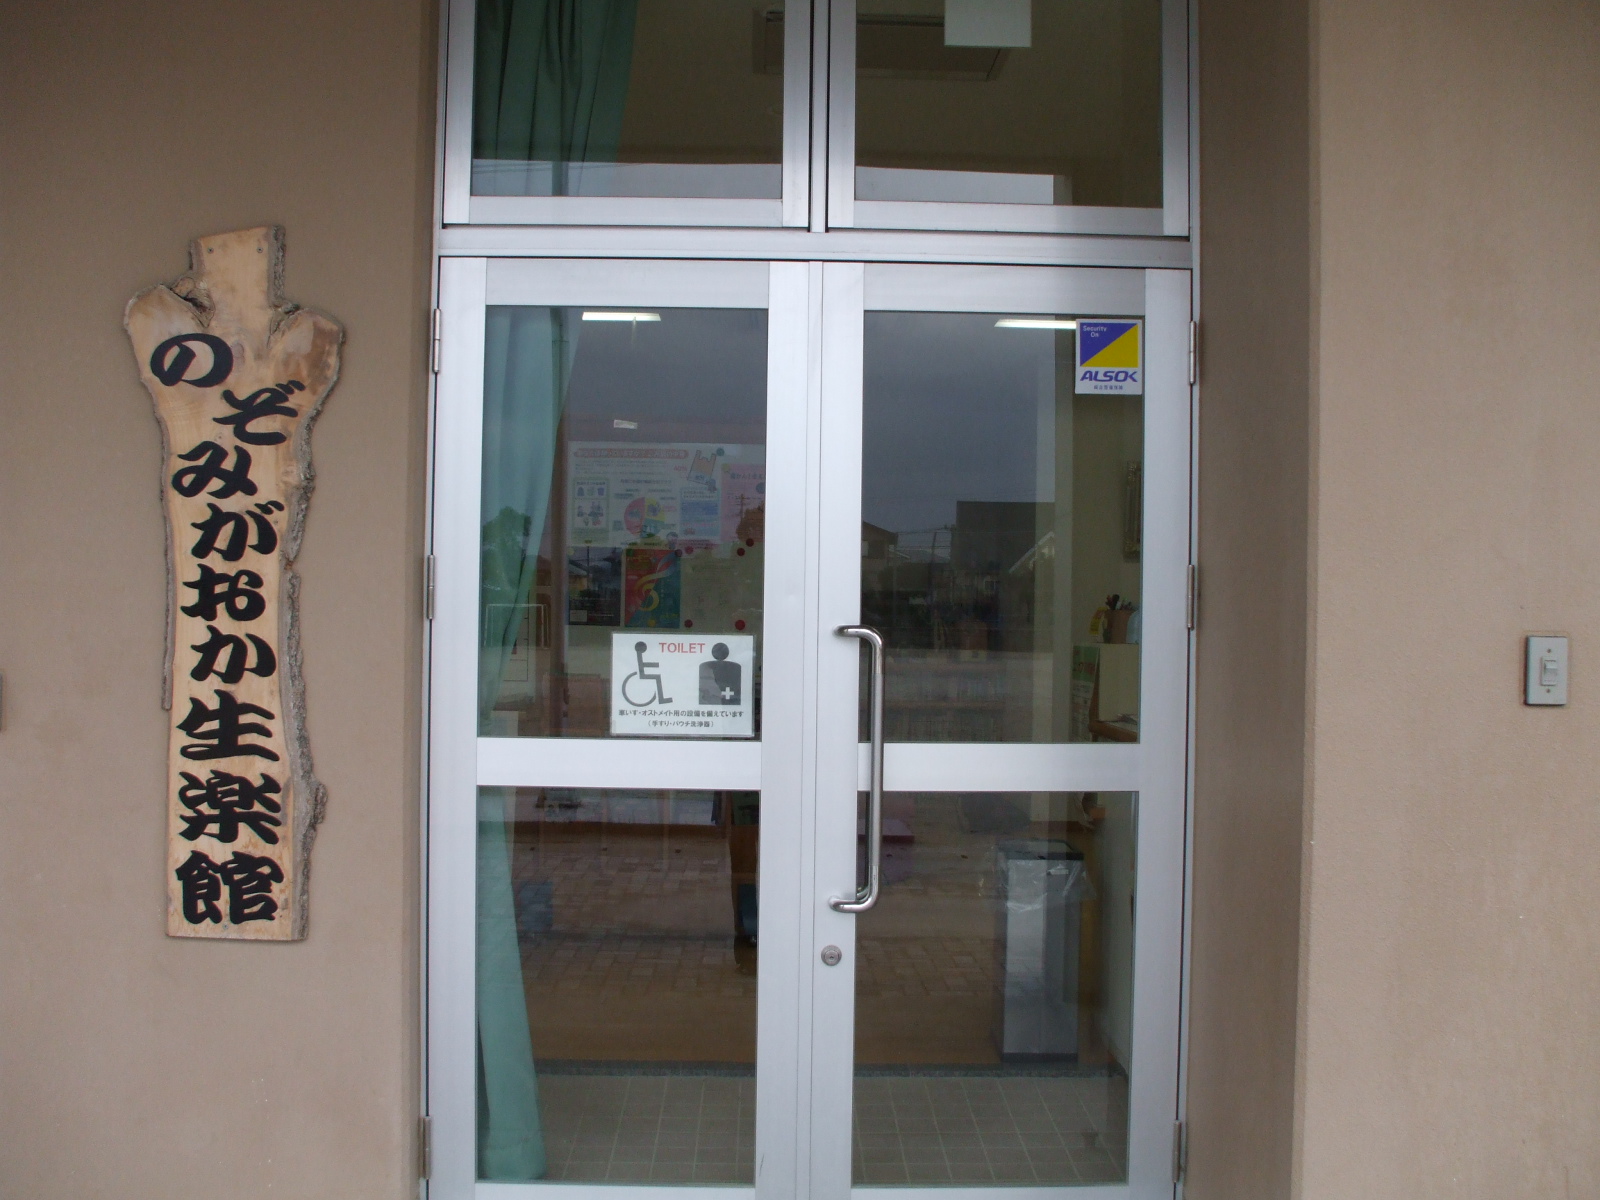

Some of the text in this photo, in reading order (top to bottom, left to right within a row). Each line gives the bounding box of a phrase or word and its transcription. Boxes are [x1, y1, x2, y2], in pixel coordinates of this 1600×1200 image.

[1080, 370, 1138, 382] ALSOK
[150, 333, 305, 926] のぞみがおか生楽館
[659, 643, 706, 653] TOILET
